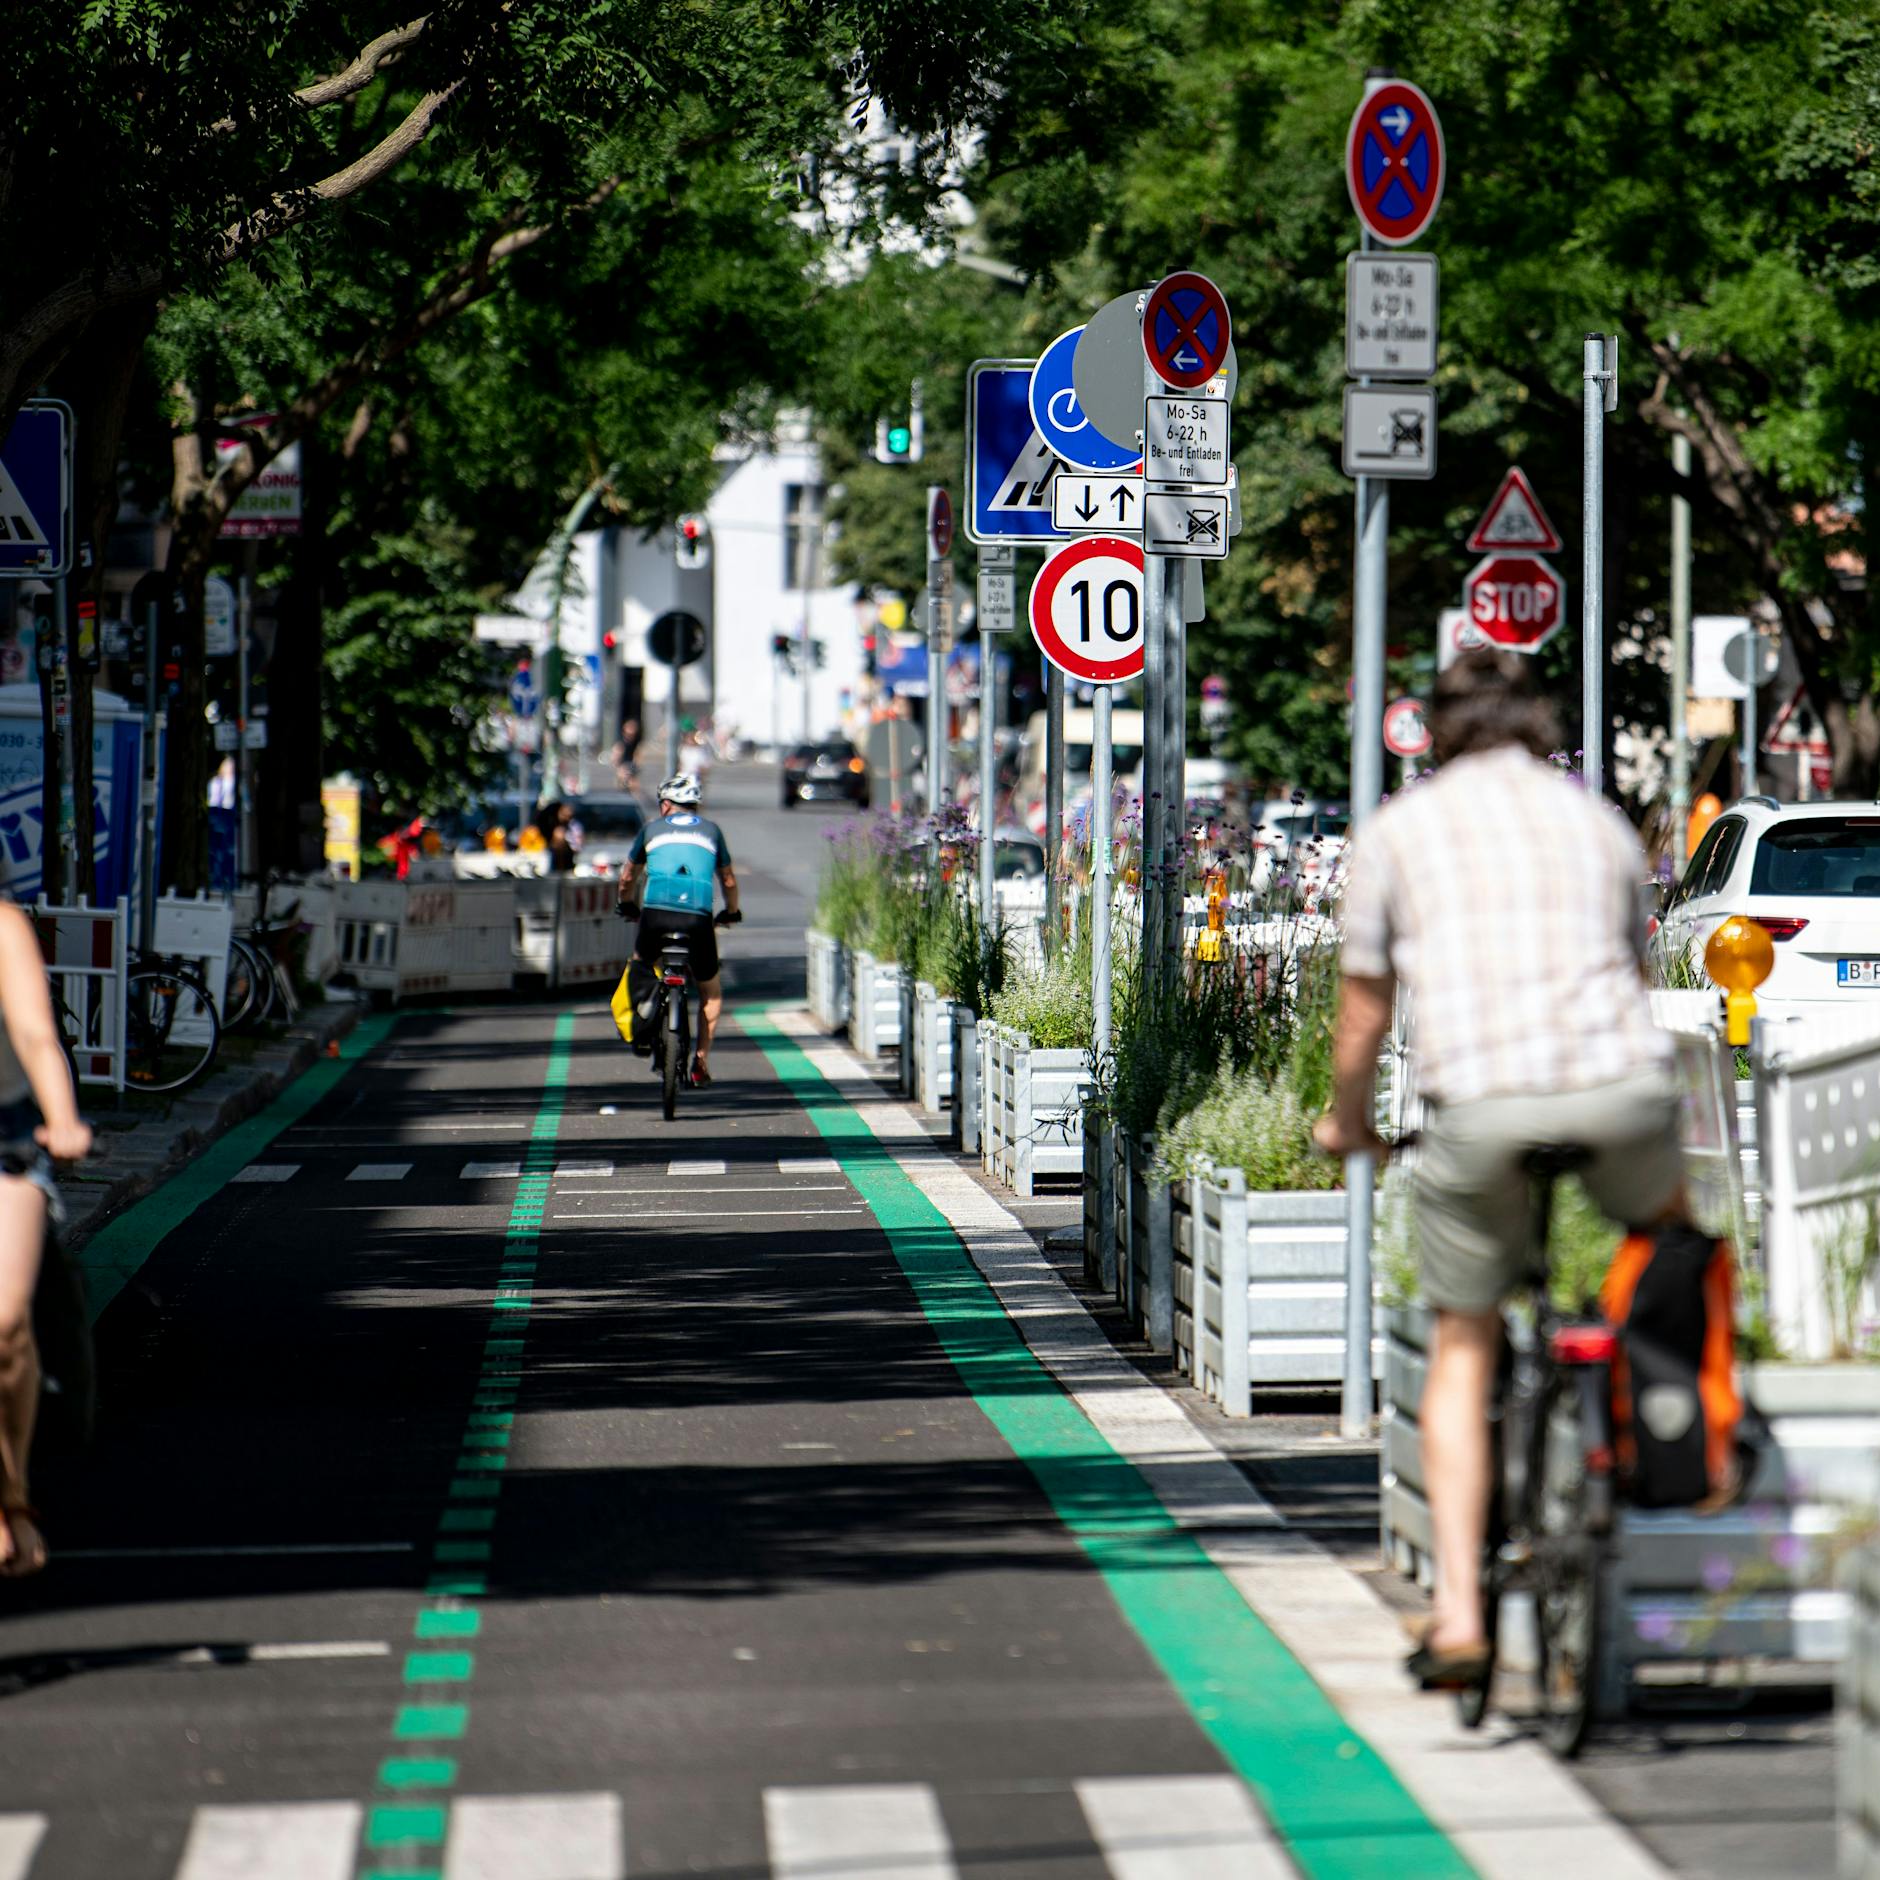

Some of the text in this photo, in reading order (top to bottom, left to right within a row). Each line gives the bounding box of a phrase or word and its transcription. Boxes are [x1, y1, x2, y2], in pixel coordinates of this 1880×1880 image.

[1167, 404, 1206, 420] Mo-Sa
[1166, 425, 1207, 441] 6-22 h
[1151, 445, 1221, 461] Be- und Entladen
[1179, 465, 1194, 477] frei
[1473, 581, 1554, 622] STOP
[1071, 580, 1139, 642] 10
[1850, 963, 1861, 979] B
